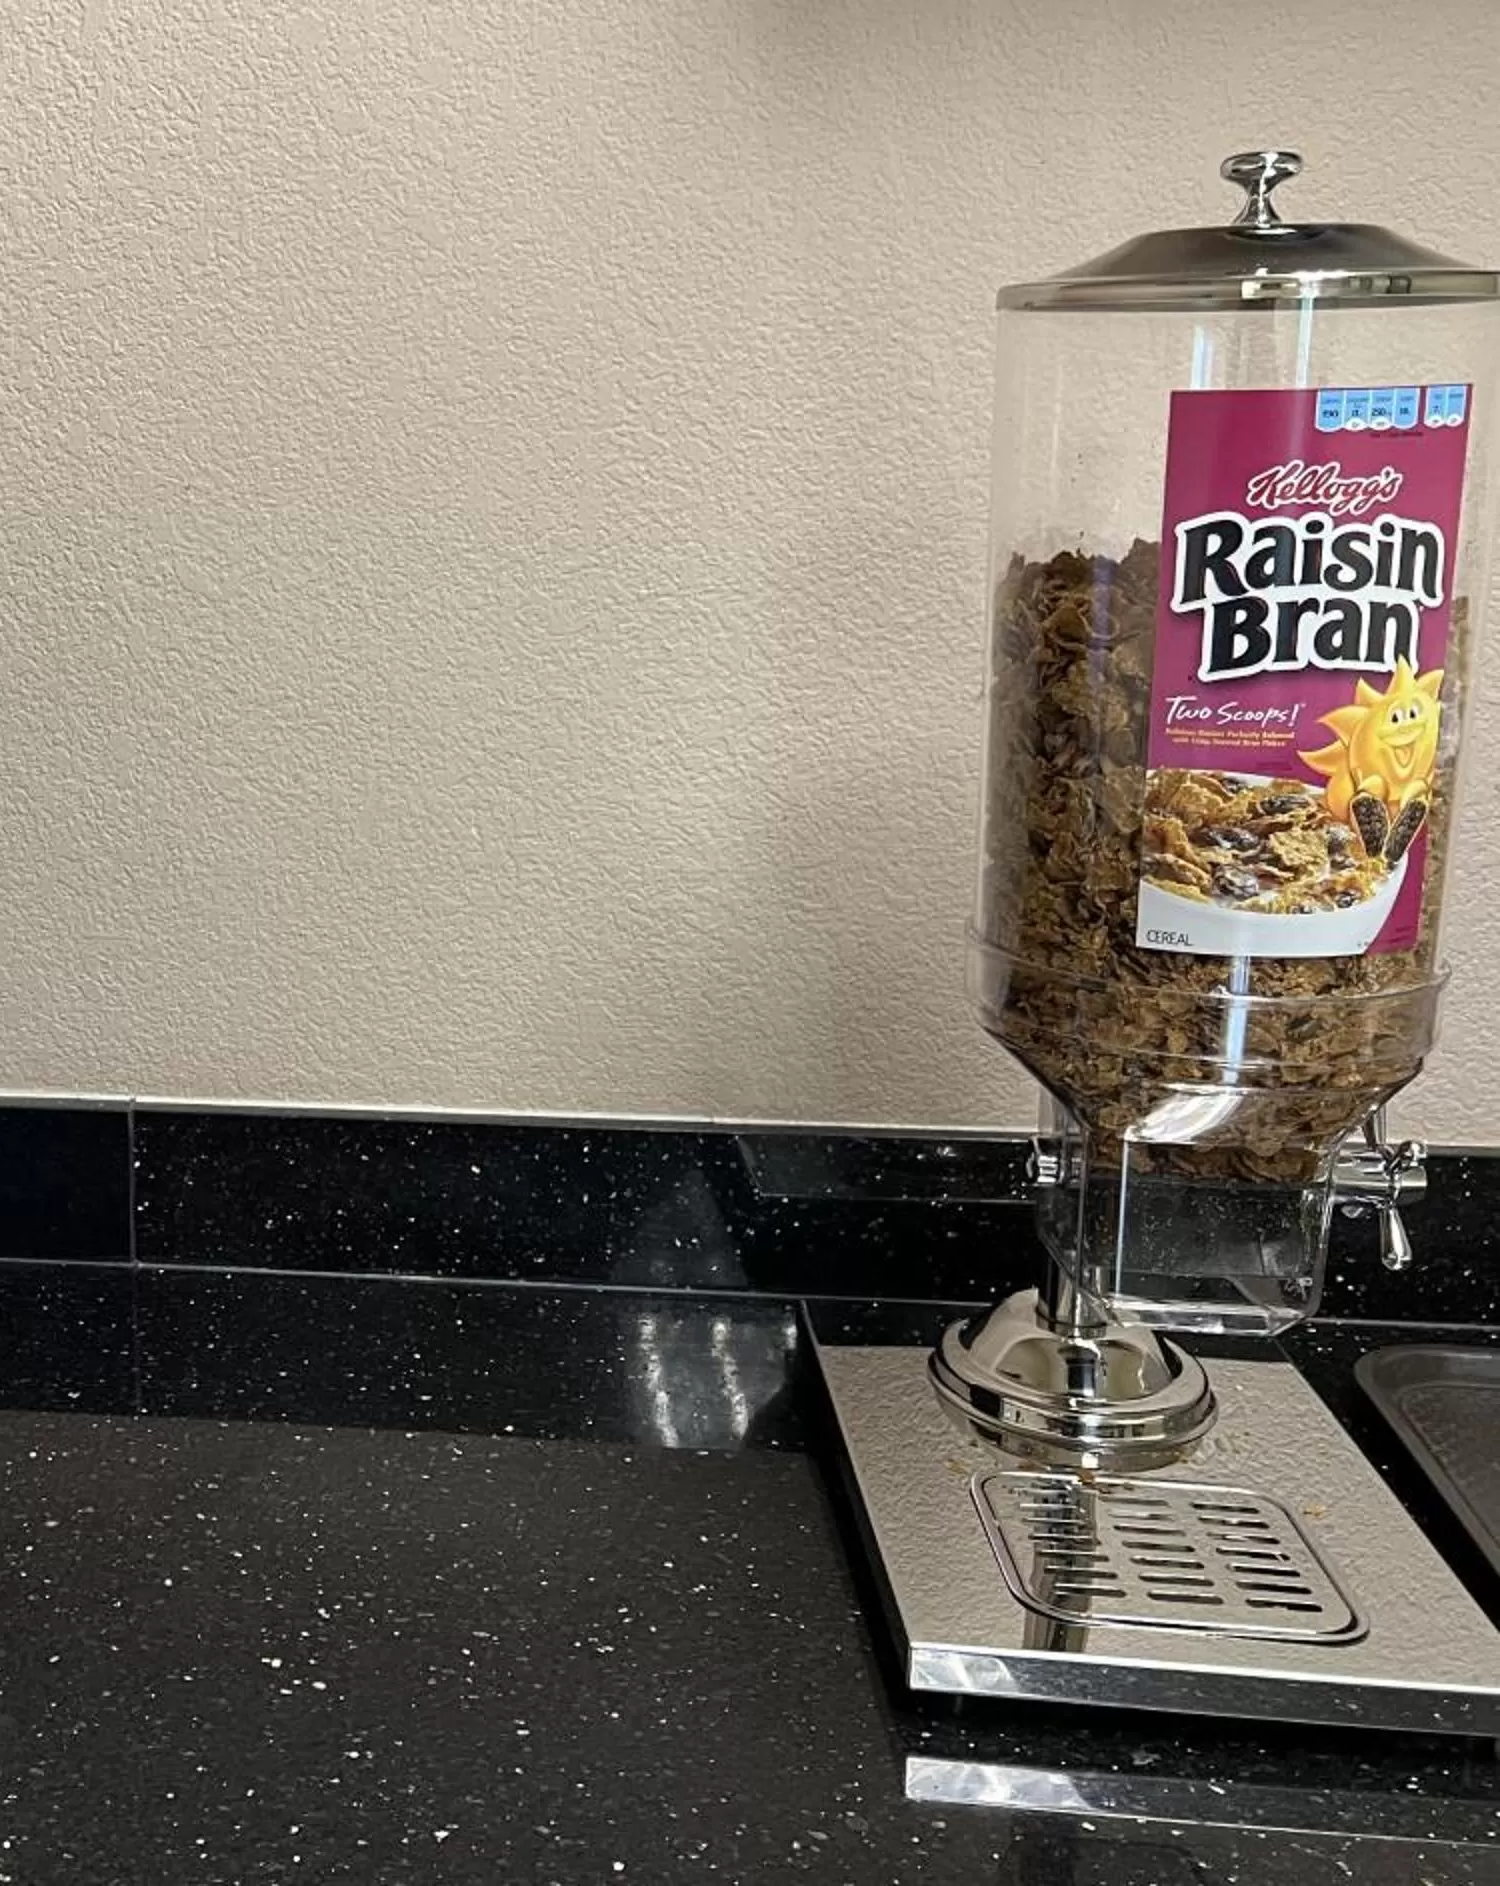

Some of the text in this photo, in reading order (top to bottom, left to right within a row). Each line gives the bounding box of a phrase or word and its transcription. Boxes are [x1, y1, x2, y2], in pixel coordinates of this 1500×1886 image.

[1246, 460, 1403, 516] Kellogg's
[1178, 518, 1440, 604] Raisin
[1206, 597, 1413, 673] Bran
[1165, 695, 1300, 729] Two Scoops!
[1147, 929, 1194, 947] CEREAL
